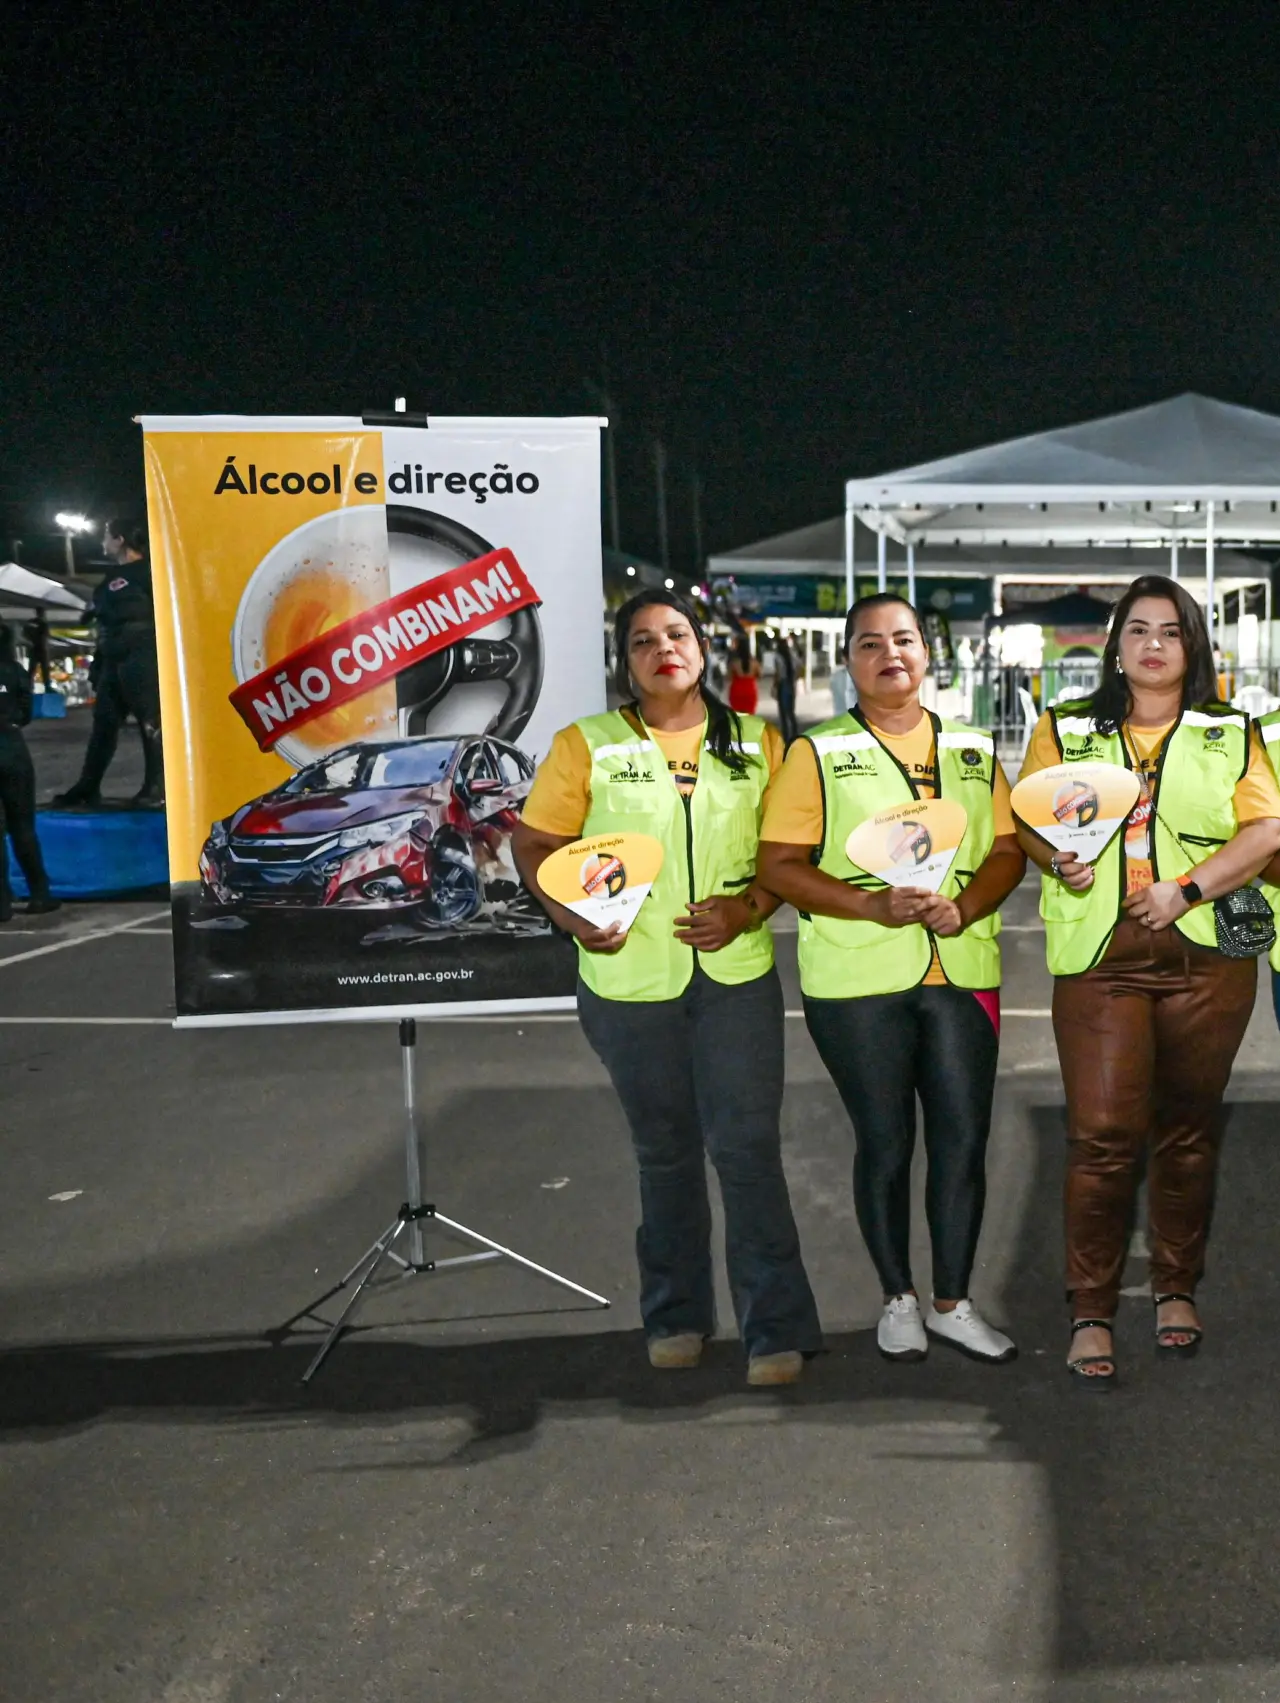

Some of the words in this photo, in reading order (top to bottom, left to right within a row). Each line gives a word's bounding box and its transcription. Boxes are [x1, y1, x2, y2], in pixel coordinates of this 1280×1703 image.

[214, 456, 341, 494] Álcool
[354, 471, 377, 494] e
[388, 464, 539, 503] direção
[252, 667, 330, 731] NÃO
[332, 561, 521, 684] COMBINAM!
[668, 761, 676, 770] E
[682, 761, 698, 772] DI
[337, 968, 474, 986] www.detran.ac.gov.br
